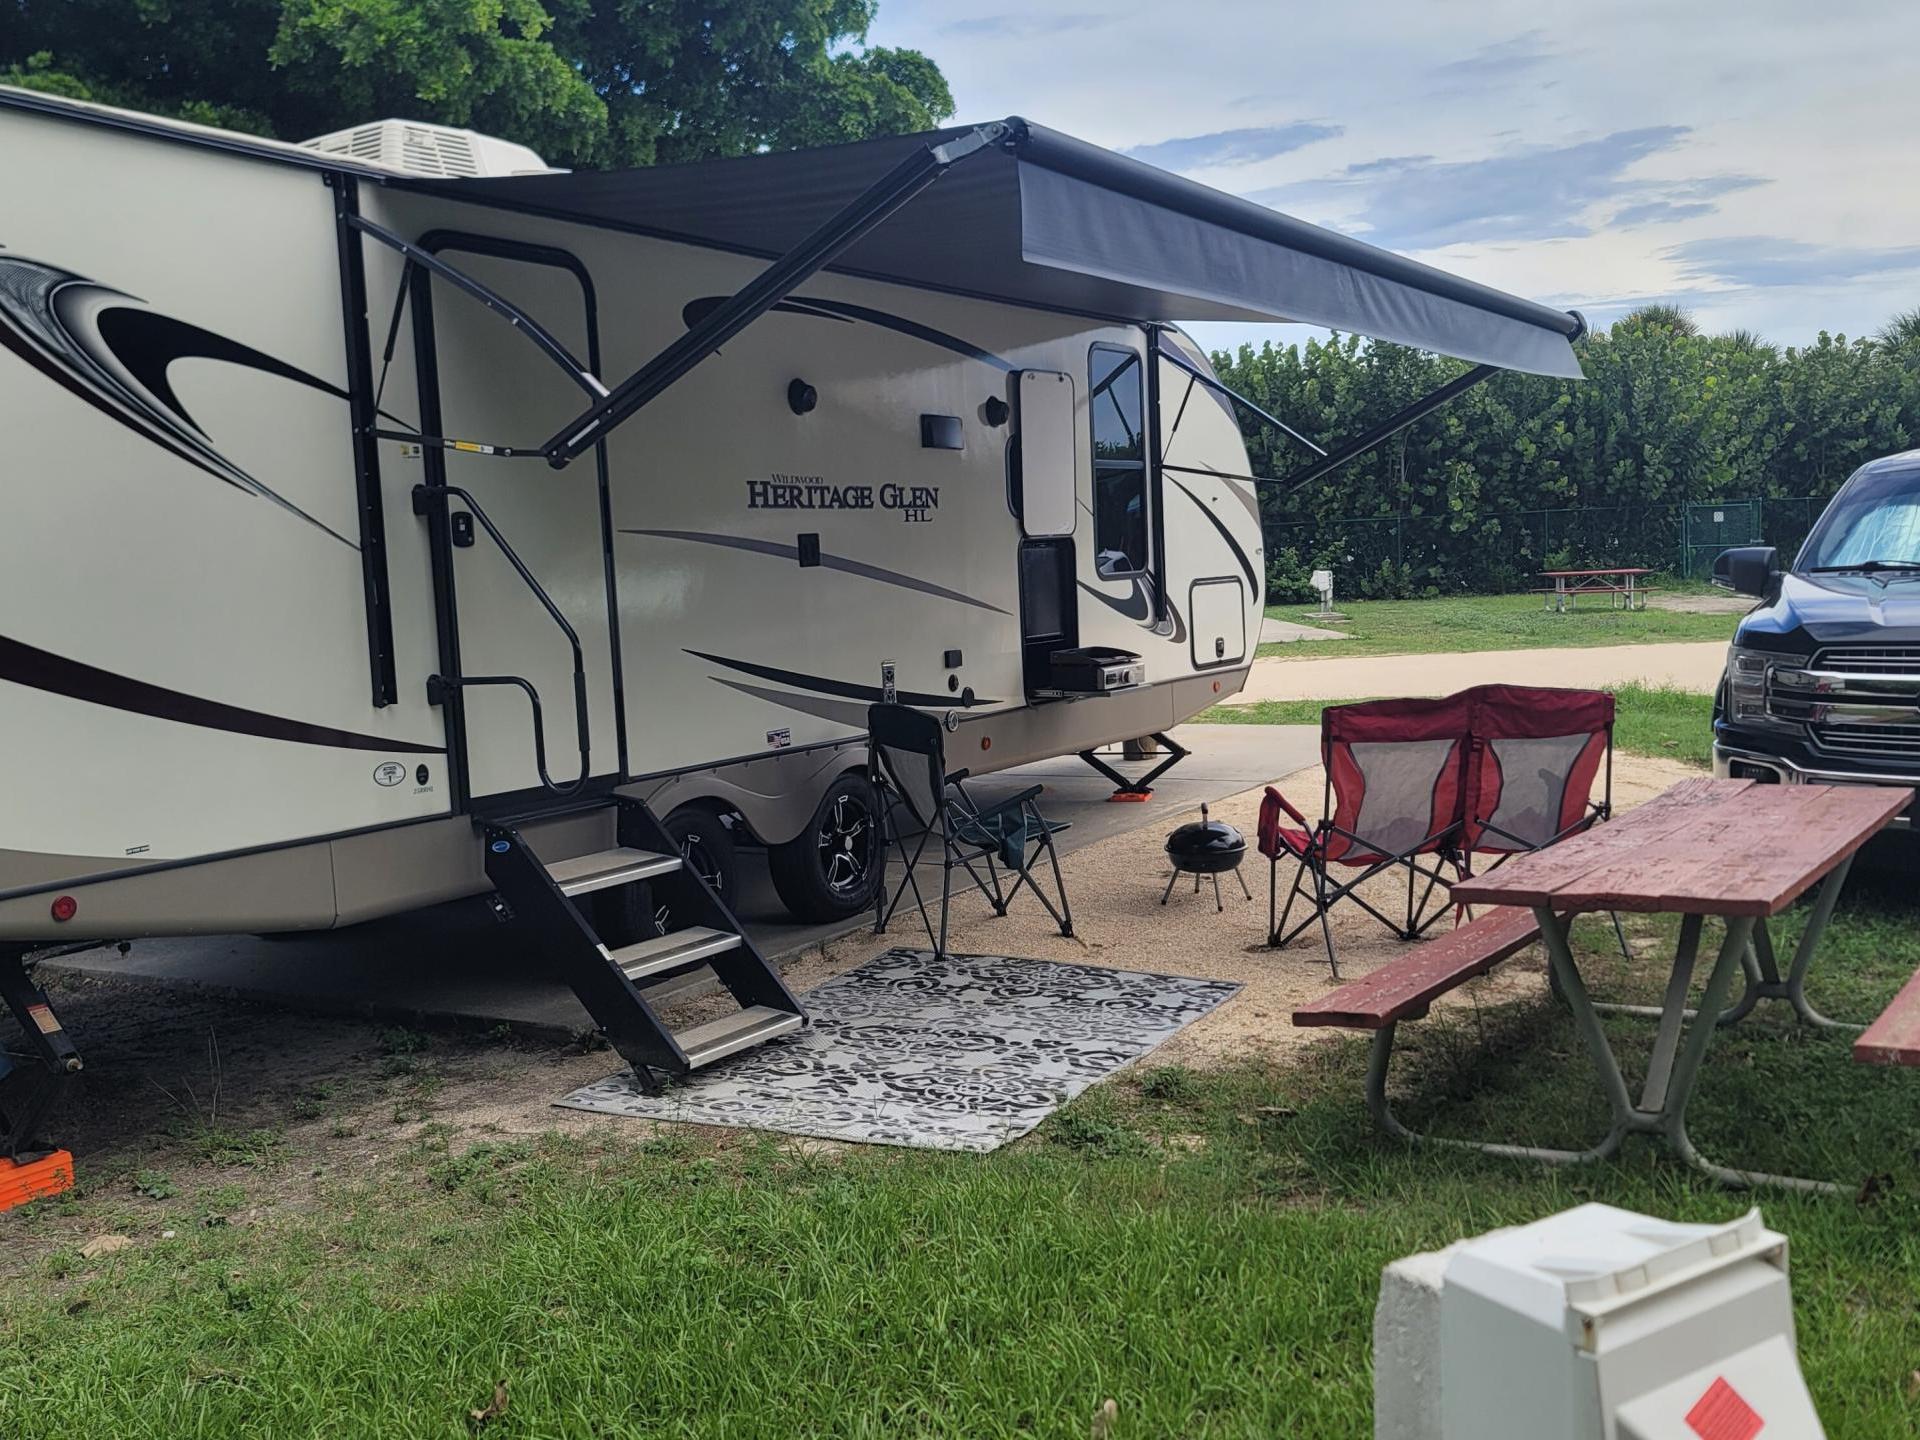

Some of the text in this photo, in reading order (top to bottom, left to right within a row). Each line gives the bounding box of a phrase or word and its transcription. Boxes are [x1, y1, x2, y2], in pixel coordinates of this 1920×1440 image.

[747, 481, 939, 509] HERITAGE GLEN
[904, 509, 933, 522] HL
